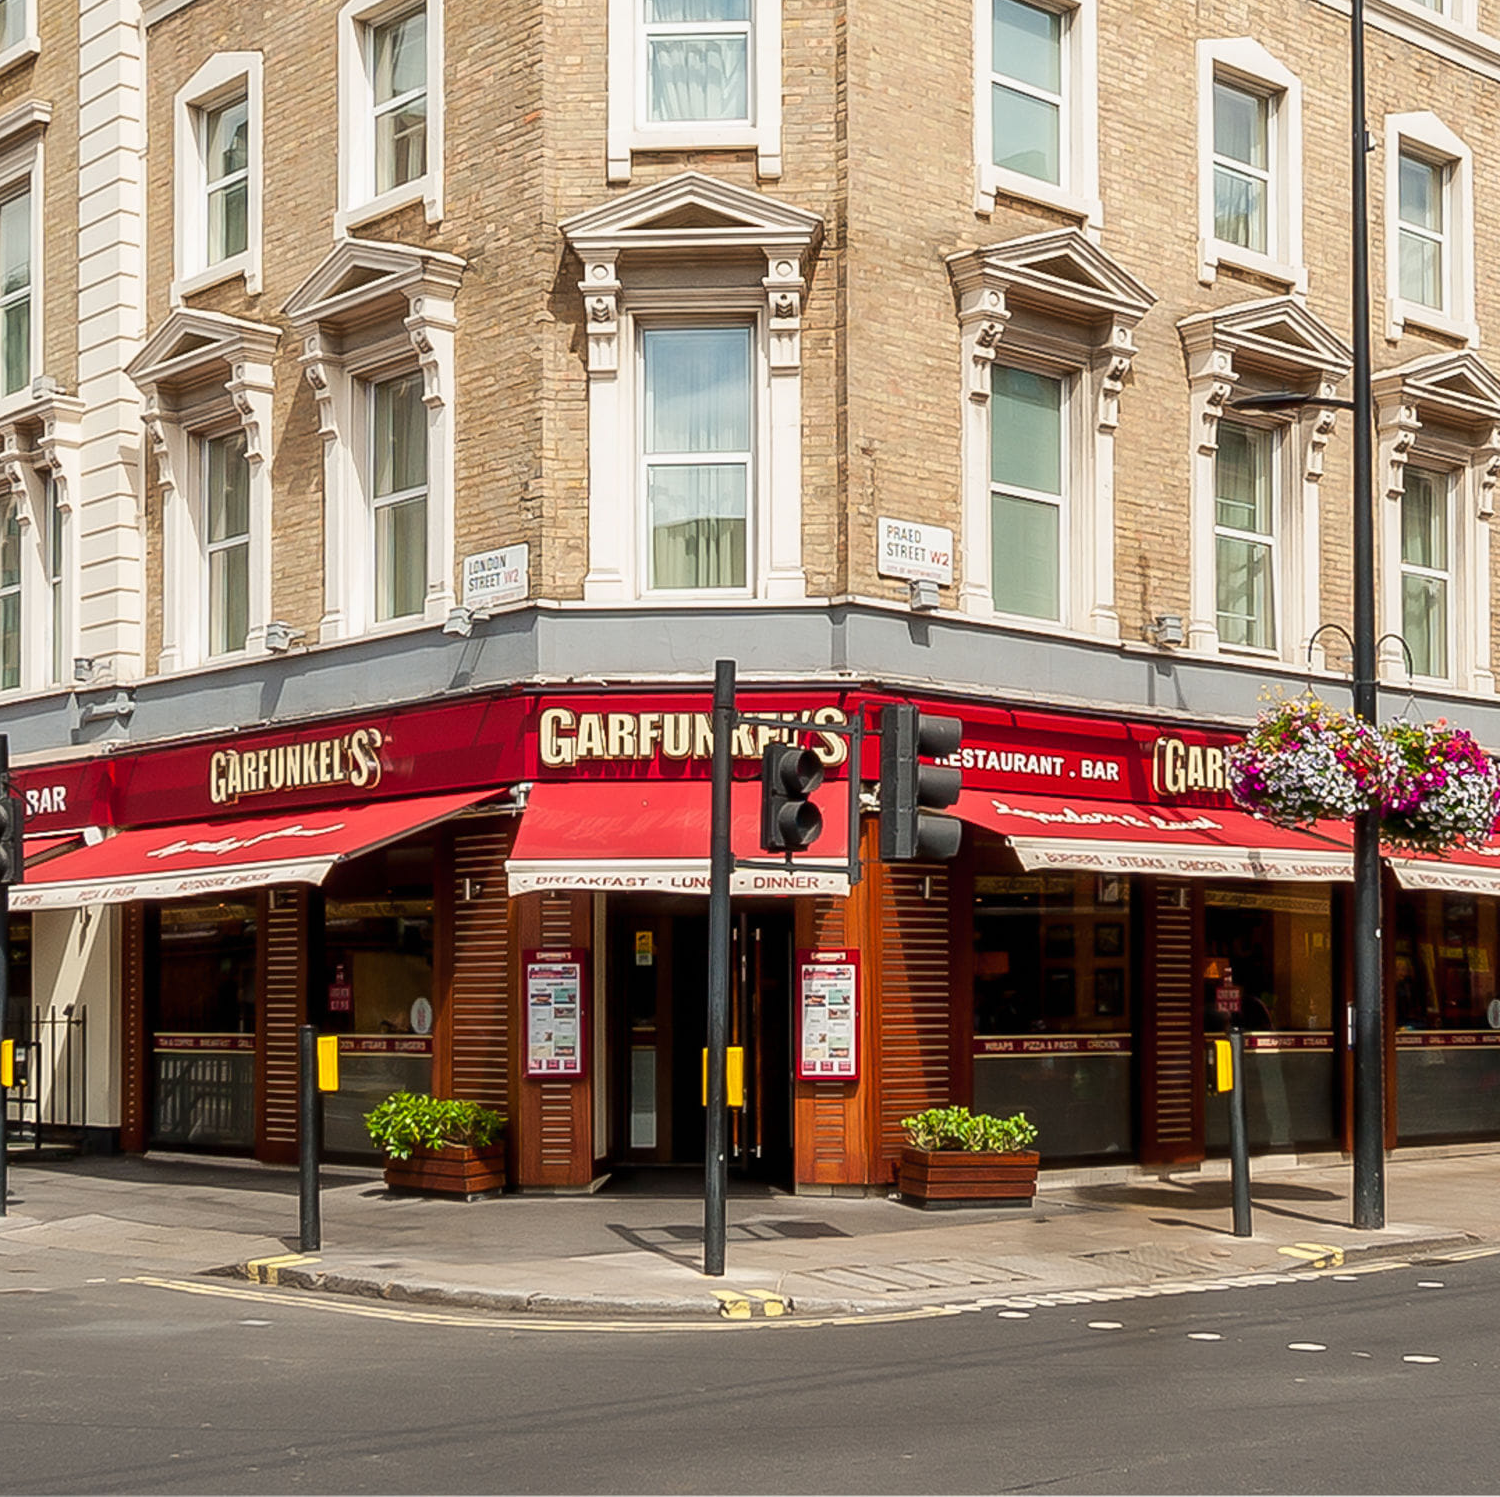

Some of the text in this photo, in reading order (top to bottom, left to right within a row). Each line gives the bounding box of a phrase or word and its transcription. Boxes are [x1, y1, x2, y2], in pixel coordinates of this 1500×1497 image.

[886, 524, 922, 544] PRAED
[468, 554, 507, 576] LONDON
[886, 542, 950, 568] STREET W2
[468, 568, 520, 592] STREET W2
[209, 728, 382, 805] GARFUNKEL'S
[1080, 759, 1121, 782] BAR
[25, 786, 67, 816] BAR
[1117, 855, 1167, 869] STEAKS
[535, 876, 650, 888] BREAKFAST
[752, 876, 820, 889] DINNER
